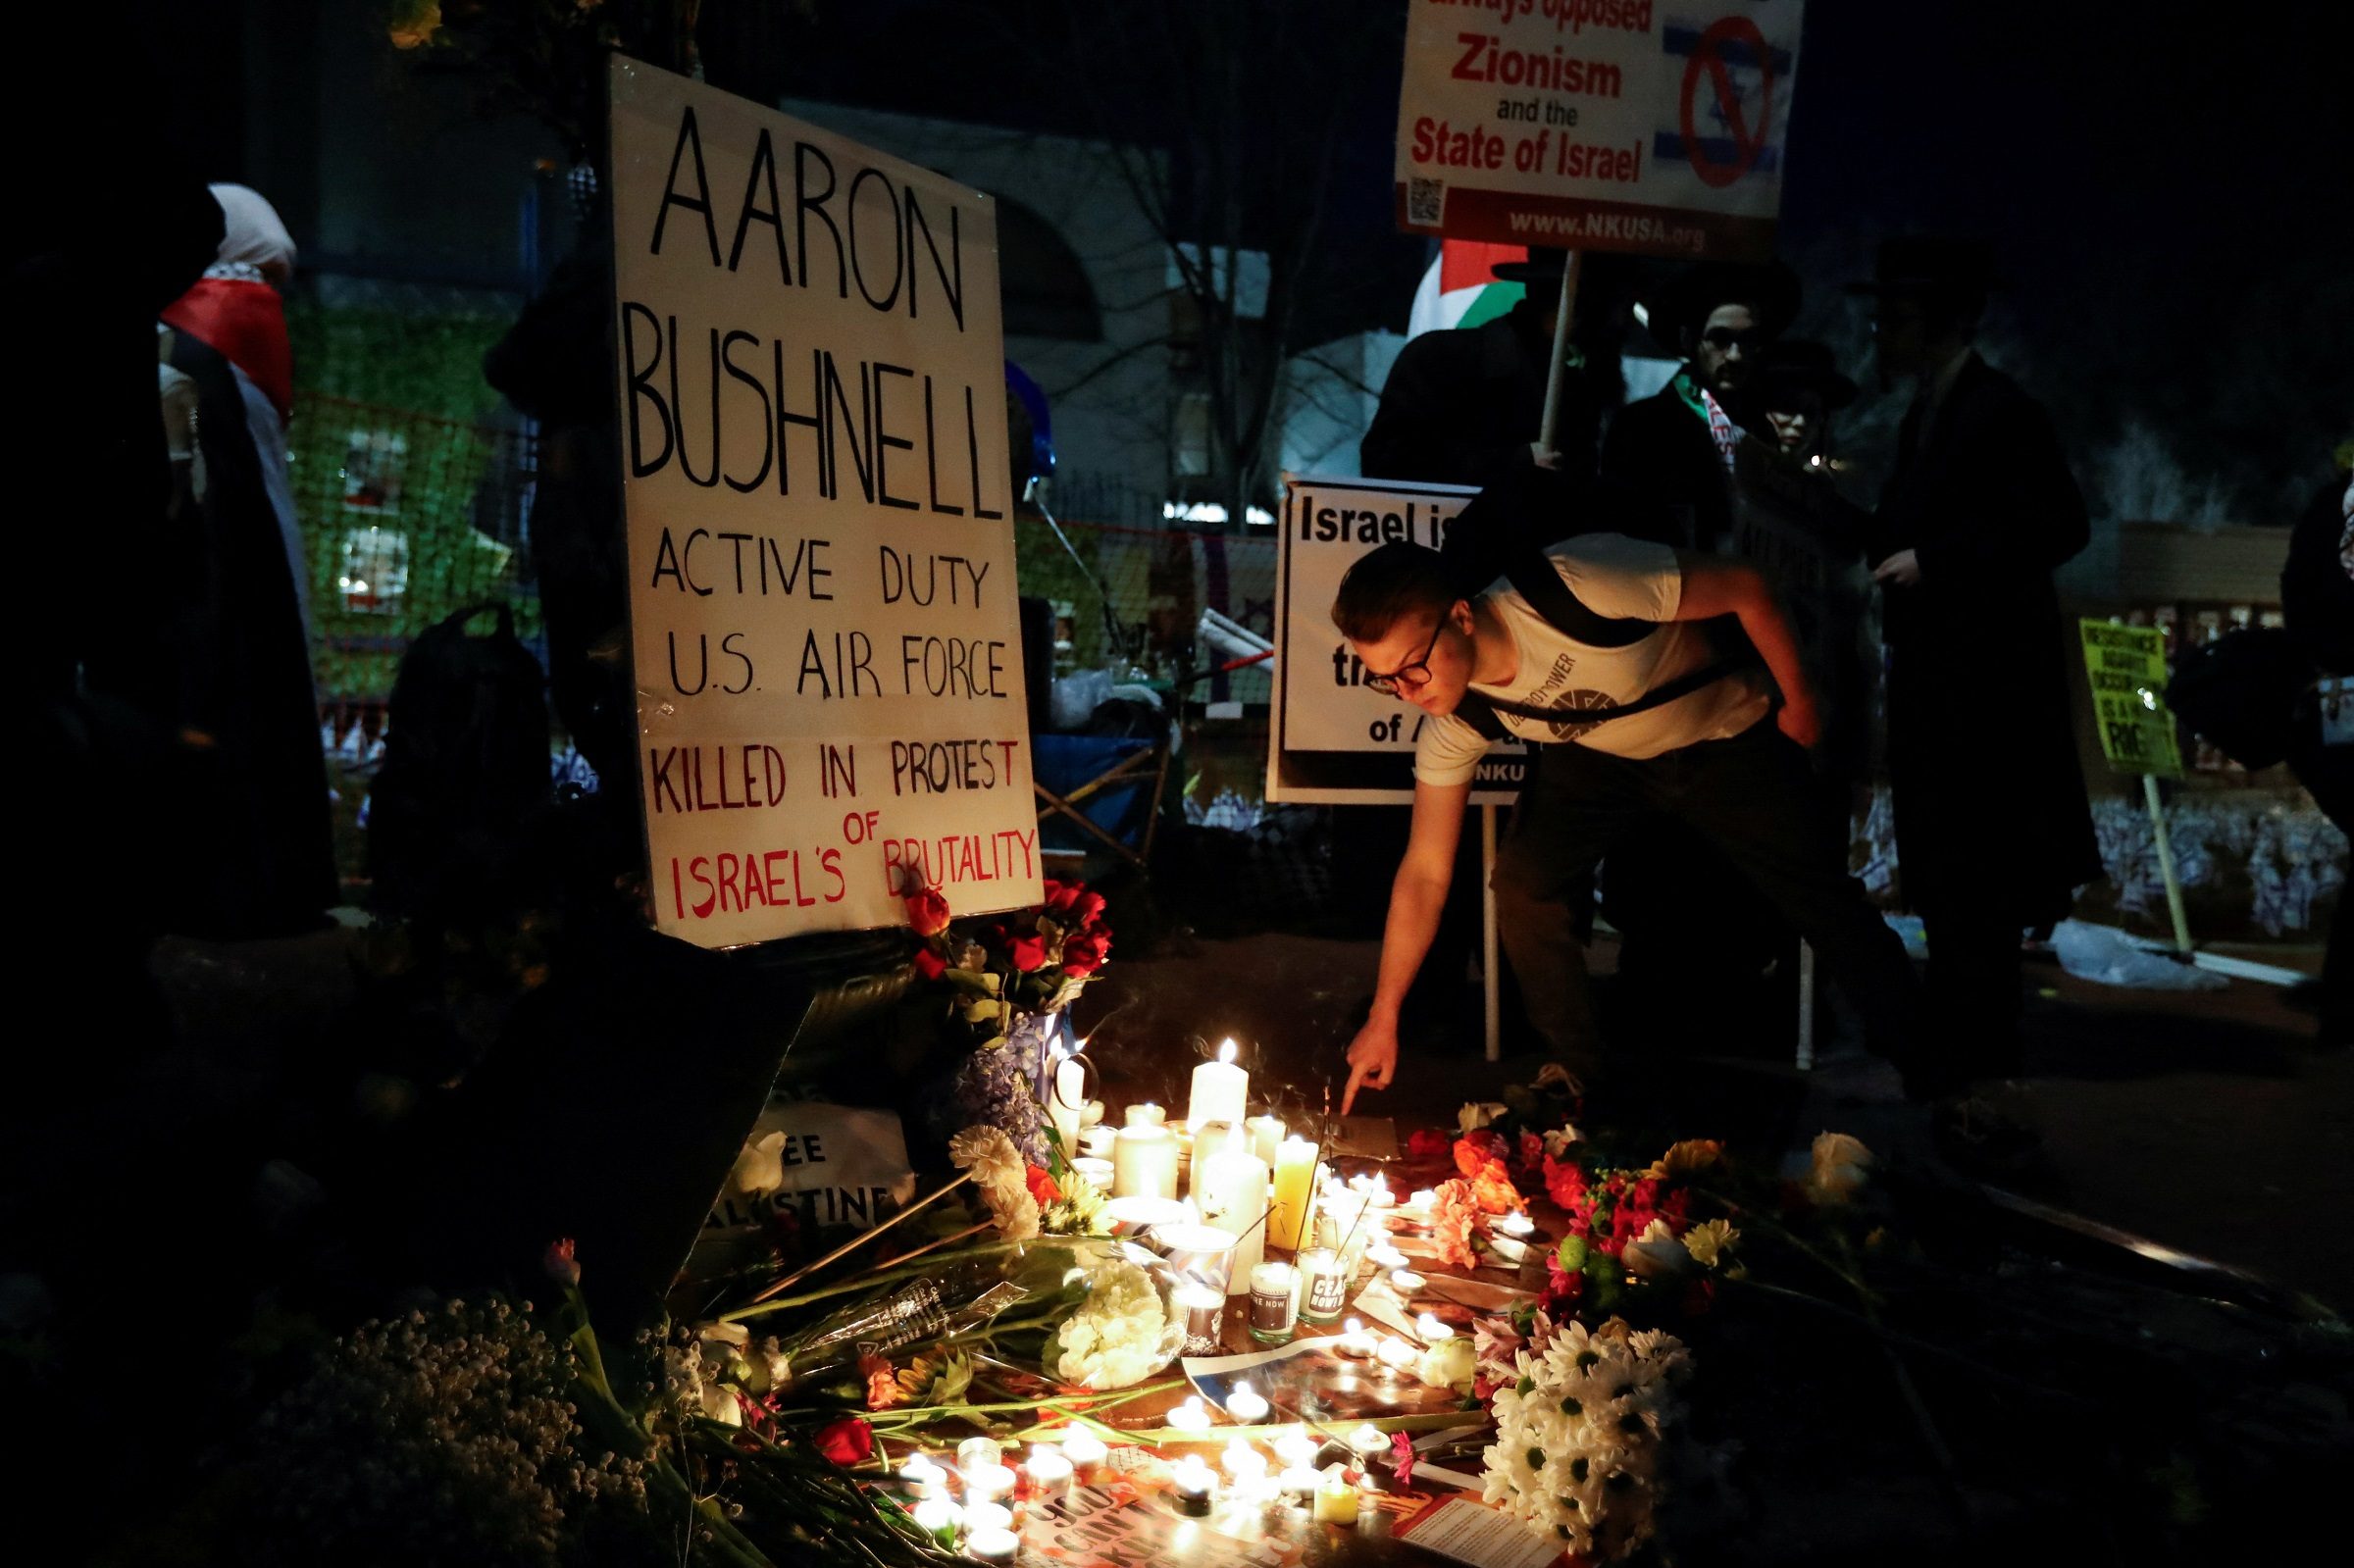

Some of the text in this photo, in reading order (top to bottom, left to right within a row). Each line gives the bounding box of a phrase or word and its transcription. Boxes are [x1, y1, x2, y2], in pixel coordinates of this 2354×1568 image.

[1542, 0, 1653, 34] opposed
[1452, 32, 1622, 98] Zionism
[1497, 98, 1578, 126] and the
[1412, 117, 1642, 183] State of Israel
[650, 106, 964, 332] AARON
[1509, 211, 1707, 253] www.NKUSA.org
[622, 301, 1003, 520] BUSHNELL
[1302, 496, 1415, 544] Israel
[651, 527, 990, 609] ACTIVE DUTY
[668, 629, 1007, 699] U.S. AIR FORCE
[1369, 714, 1402, 742] of
[650, 739, 1018, 813] KILLED IN PROTEST
[844, 811, 880, 845] OF
[672, 829, 1037, 920] ISRAEL'S BRUTALITY
[783, 1135, 827, 1166] EE
